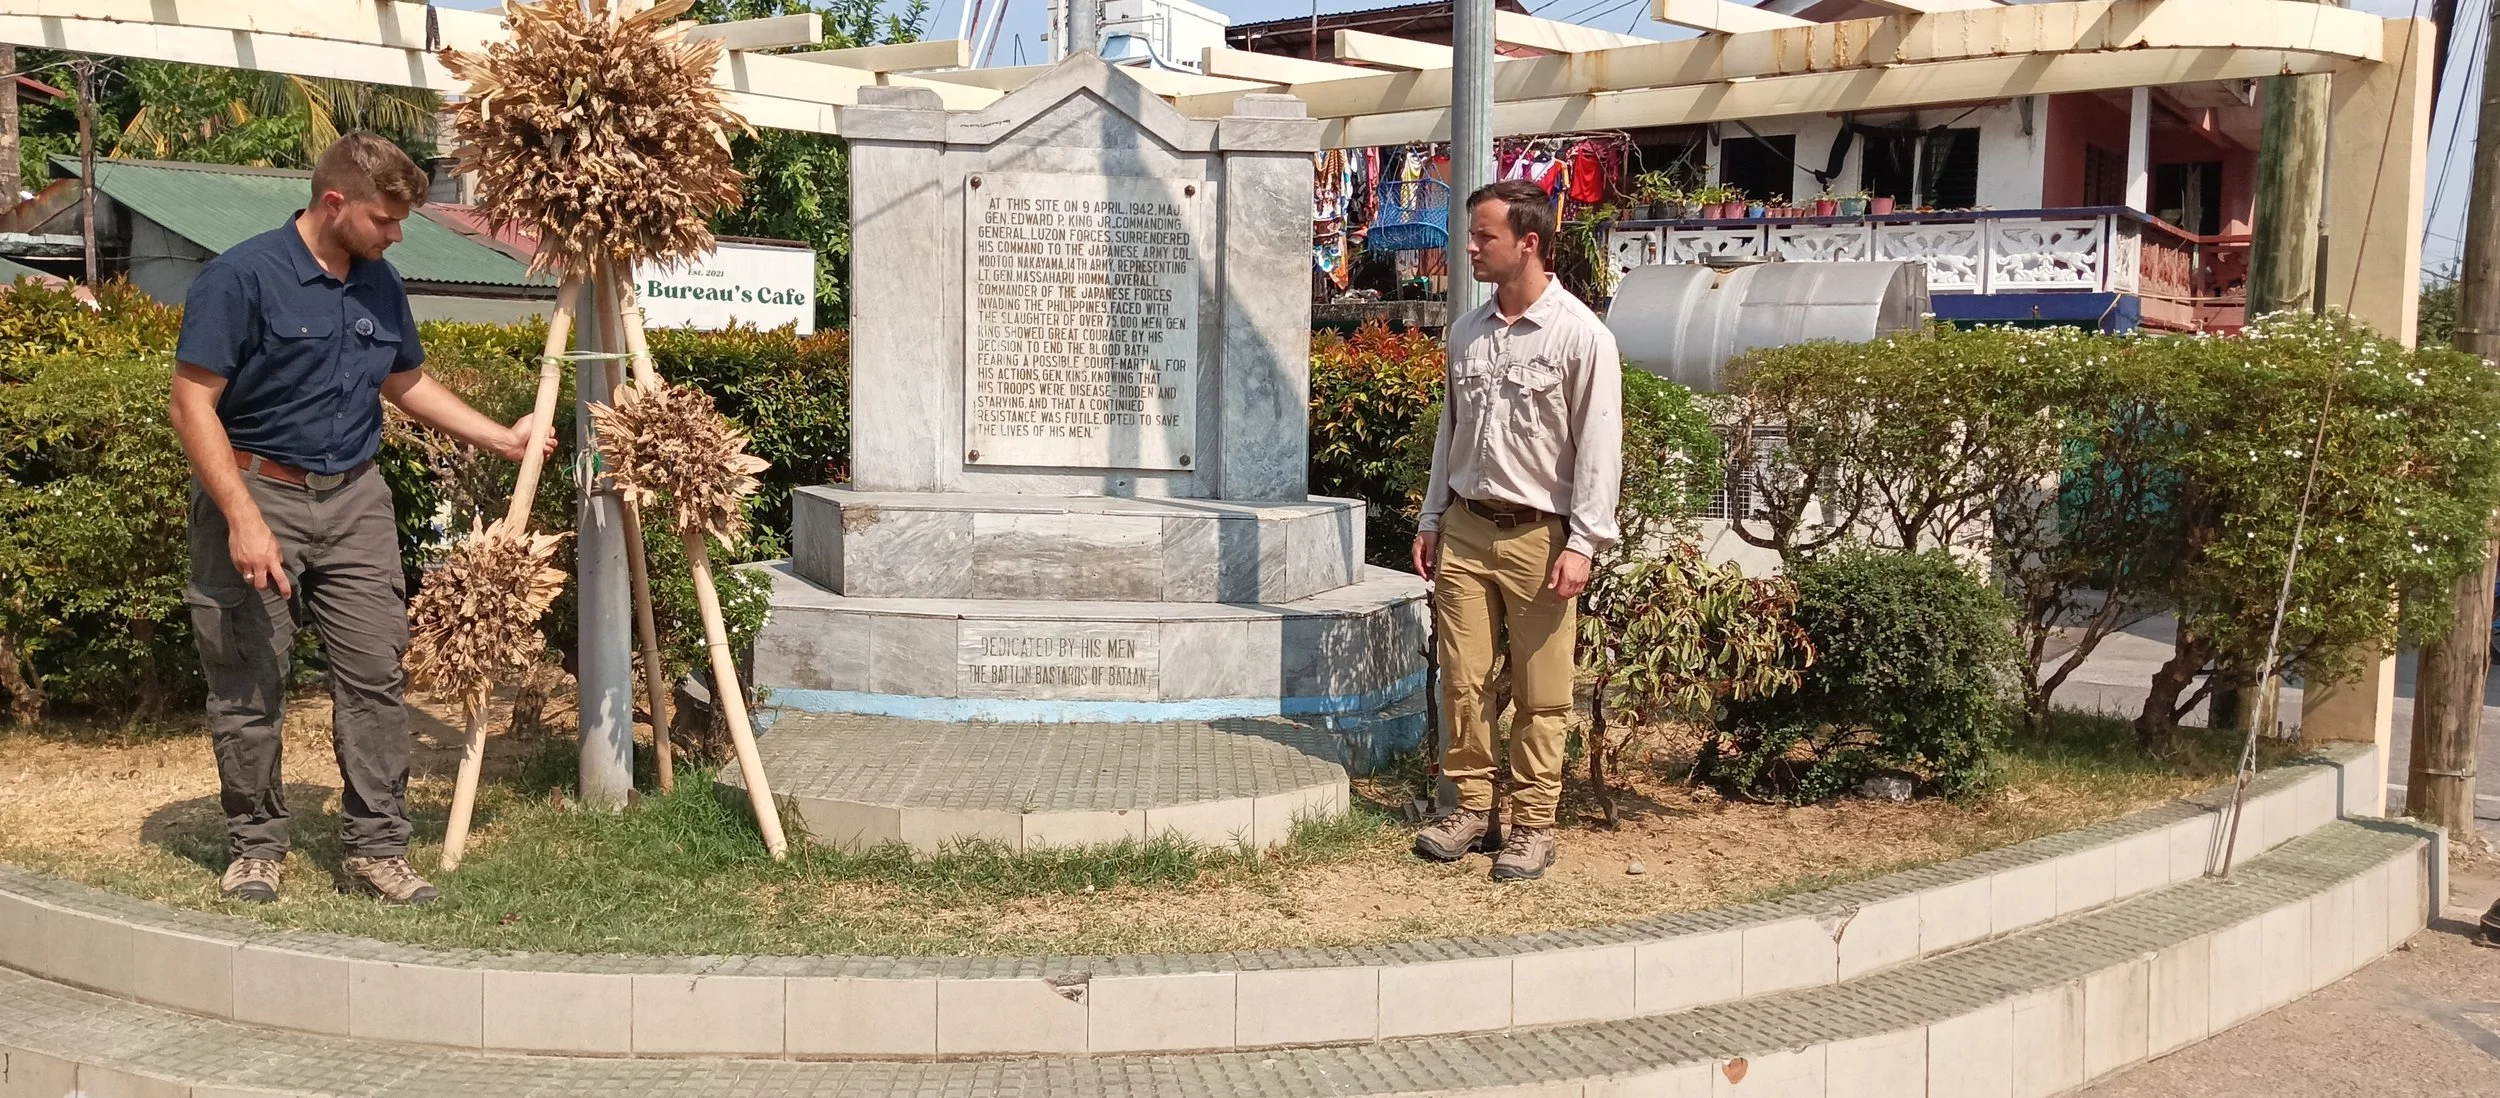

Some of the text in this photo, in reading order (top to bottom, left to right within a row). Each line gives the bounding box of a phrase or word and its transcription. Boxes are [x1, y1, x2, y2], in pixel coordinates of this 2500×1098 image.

[1007, 198, 1031, 211] THIS
[1035, 199, 1059, 211] SITE
[1064, 200, 1078, 212] ON
[1083, 200, 1090, 213] 9
[985, 211, 1009, 225] GEN.
[1011, 213, 1053, 226] EDWARD
[1068, 214, 1093, 227] KING
[1116, 216, 1181, 230] COMMANDING
[1031, 228, 1066, 241] LUZON
[1115, 231, 1190, 245] SURRENDERED
[978, 240, 1194, 261] HIS COMMAND TO THE JAPANESE ARMY COL.
[687, 268, 725, 278] Est. 2021
[978, 255, 1014, 268] MOOTOO
[1118, 259, 1186, 274] REPRESENTING
[978, 269, 991, 281] LT.
[993, 269, 1015, 282] GEN.
[1016, 270, 1074, 284] MASSAHARU
[1114, 273, 1158, 287] OVERALL
[647, 280, 753, 303] Bureau's
[757, 287, 805, 305] Cafe
[978, 283, 1172, 302] COMMANDER OF THE JAPANESE FORCES
[978, 297, 1021, 310] INVADING
[1024, 299, 1044, 312] THE
[1110, 302, 1141, 315] FACED
[1146, 303, 1169, 316] WITH
[978, 310, 997, 324] THE
[1001, 312, 1059, 326] SLAUGHTER
[1063, 313, 1076, 326] OF
[1079, 315, 1103, 327] OVER
[1141, 316, 1162, 329] MEN
[1166, 317, 1189, 330] GEN.
[978, 325, 1164, 343] KING SHOWED GREAT COURAGE BY HIS
[978, 338, 1149, 356] DECISION TO END THE BLOOD BATH
[977, 353, 1186, 372] FEARING A POSSIBLE COURT-MARTIAL FOR
[978, 367, 994, 380] HIS
[998, 368, 1041, 382] ACTIONS,
[1042, 369, 1063, 382] GEN.
[1091, 371, 1134, 384] KNOWING
[1138, 372, 1161, 385] THAT
[978, 381, 993, 394] HIS
[997, 381, 1035, 395] TROOPS
[1039, 383, 1066, 396] WERE
[1158, 387, 1177, 399] AND
[1029, 397, 1047, 409] AND
[1051, 398, 1075, 410] THAT
[1079, 398, 1085, 410] A
[1090, 399, 1144, 412] CONTINUED
[977, 409, 1037, 423] RESISTANCE
[1041, 411, 1061, 424] WAS
[1103, 413, 1135, 426] OPTED
[1140, 414, 1151, 426] TO
[1155, 415, 1179, 427] SAVE
[978, 424, 996, 436] THE
[1000, 424, 1029, 437] LIVES
[1033, 425, 1045, 437] OF
[1049, 425, 1065, 437] HIS
[981, 637, 1135, 659] DEDICATED BY HIS MEN
[968, 664, 987, 683] THE
[1036, 665, 1087, 686] BASTARDS
[1091, 666, 1103, 685] OF
[1109, 666, 1146, 687] BATAAN
